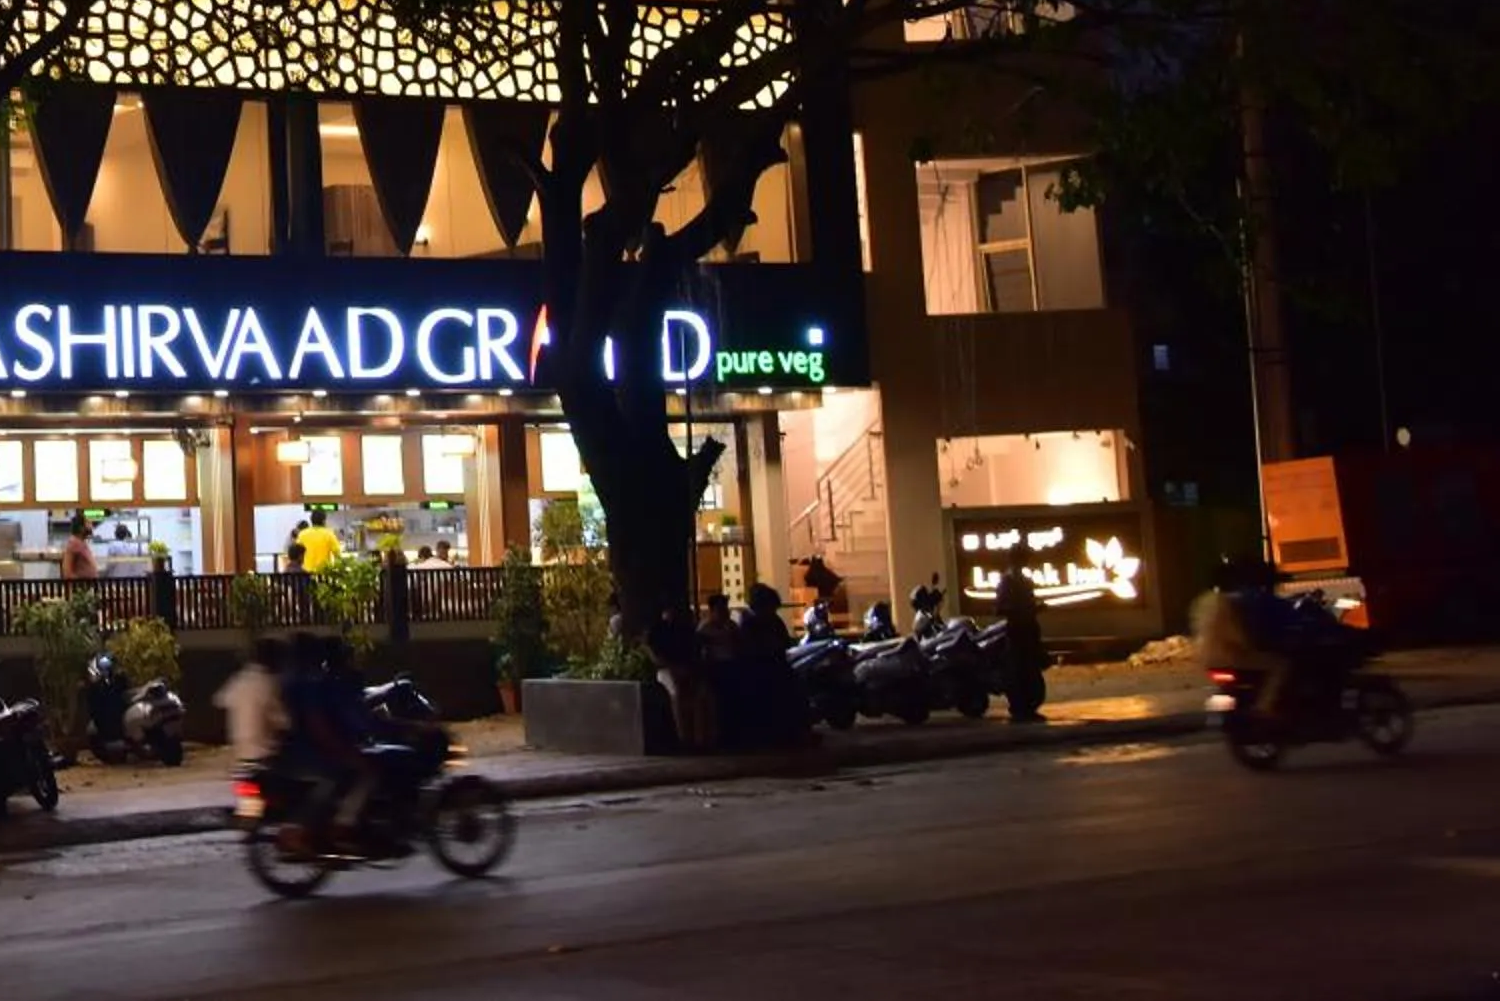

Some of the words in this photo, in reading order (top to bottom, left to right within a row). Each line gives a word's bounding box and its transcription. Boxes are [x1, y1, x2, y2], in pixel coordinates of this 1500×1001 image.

[416, 304, 712, 384] GRD
[717, 348, 773, 379] pure
[777, 350, 823, 382] veg
